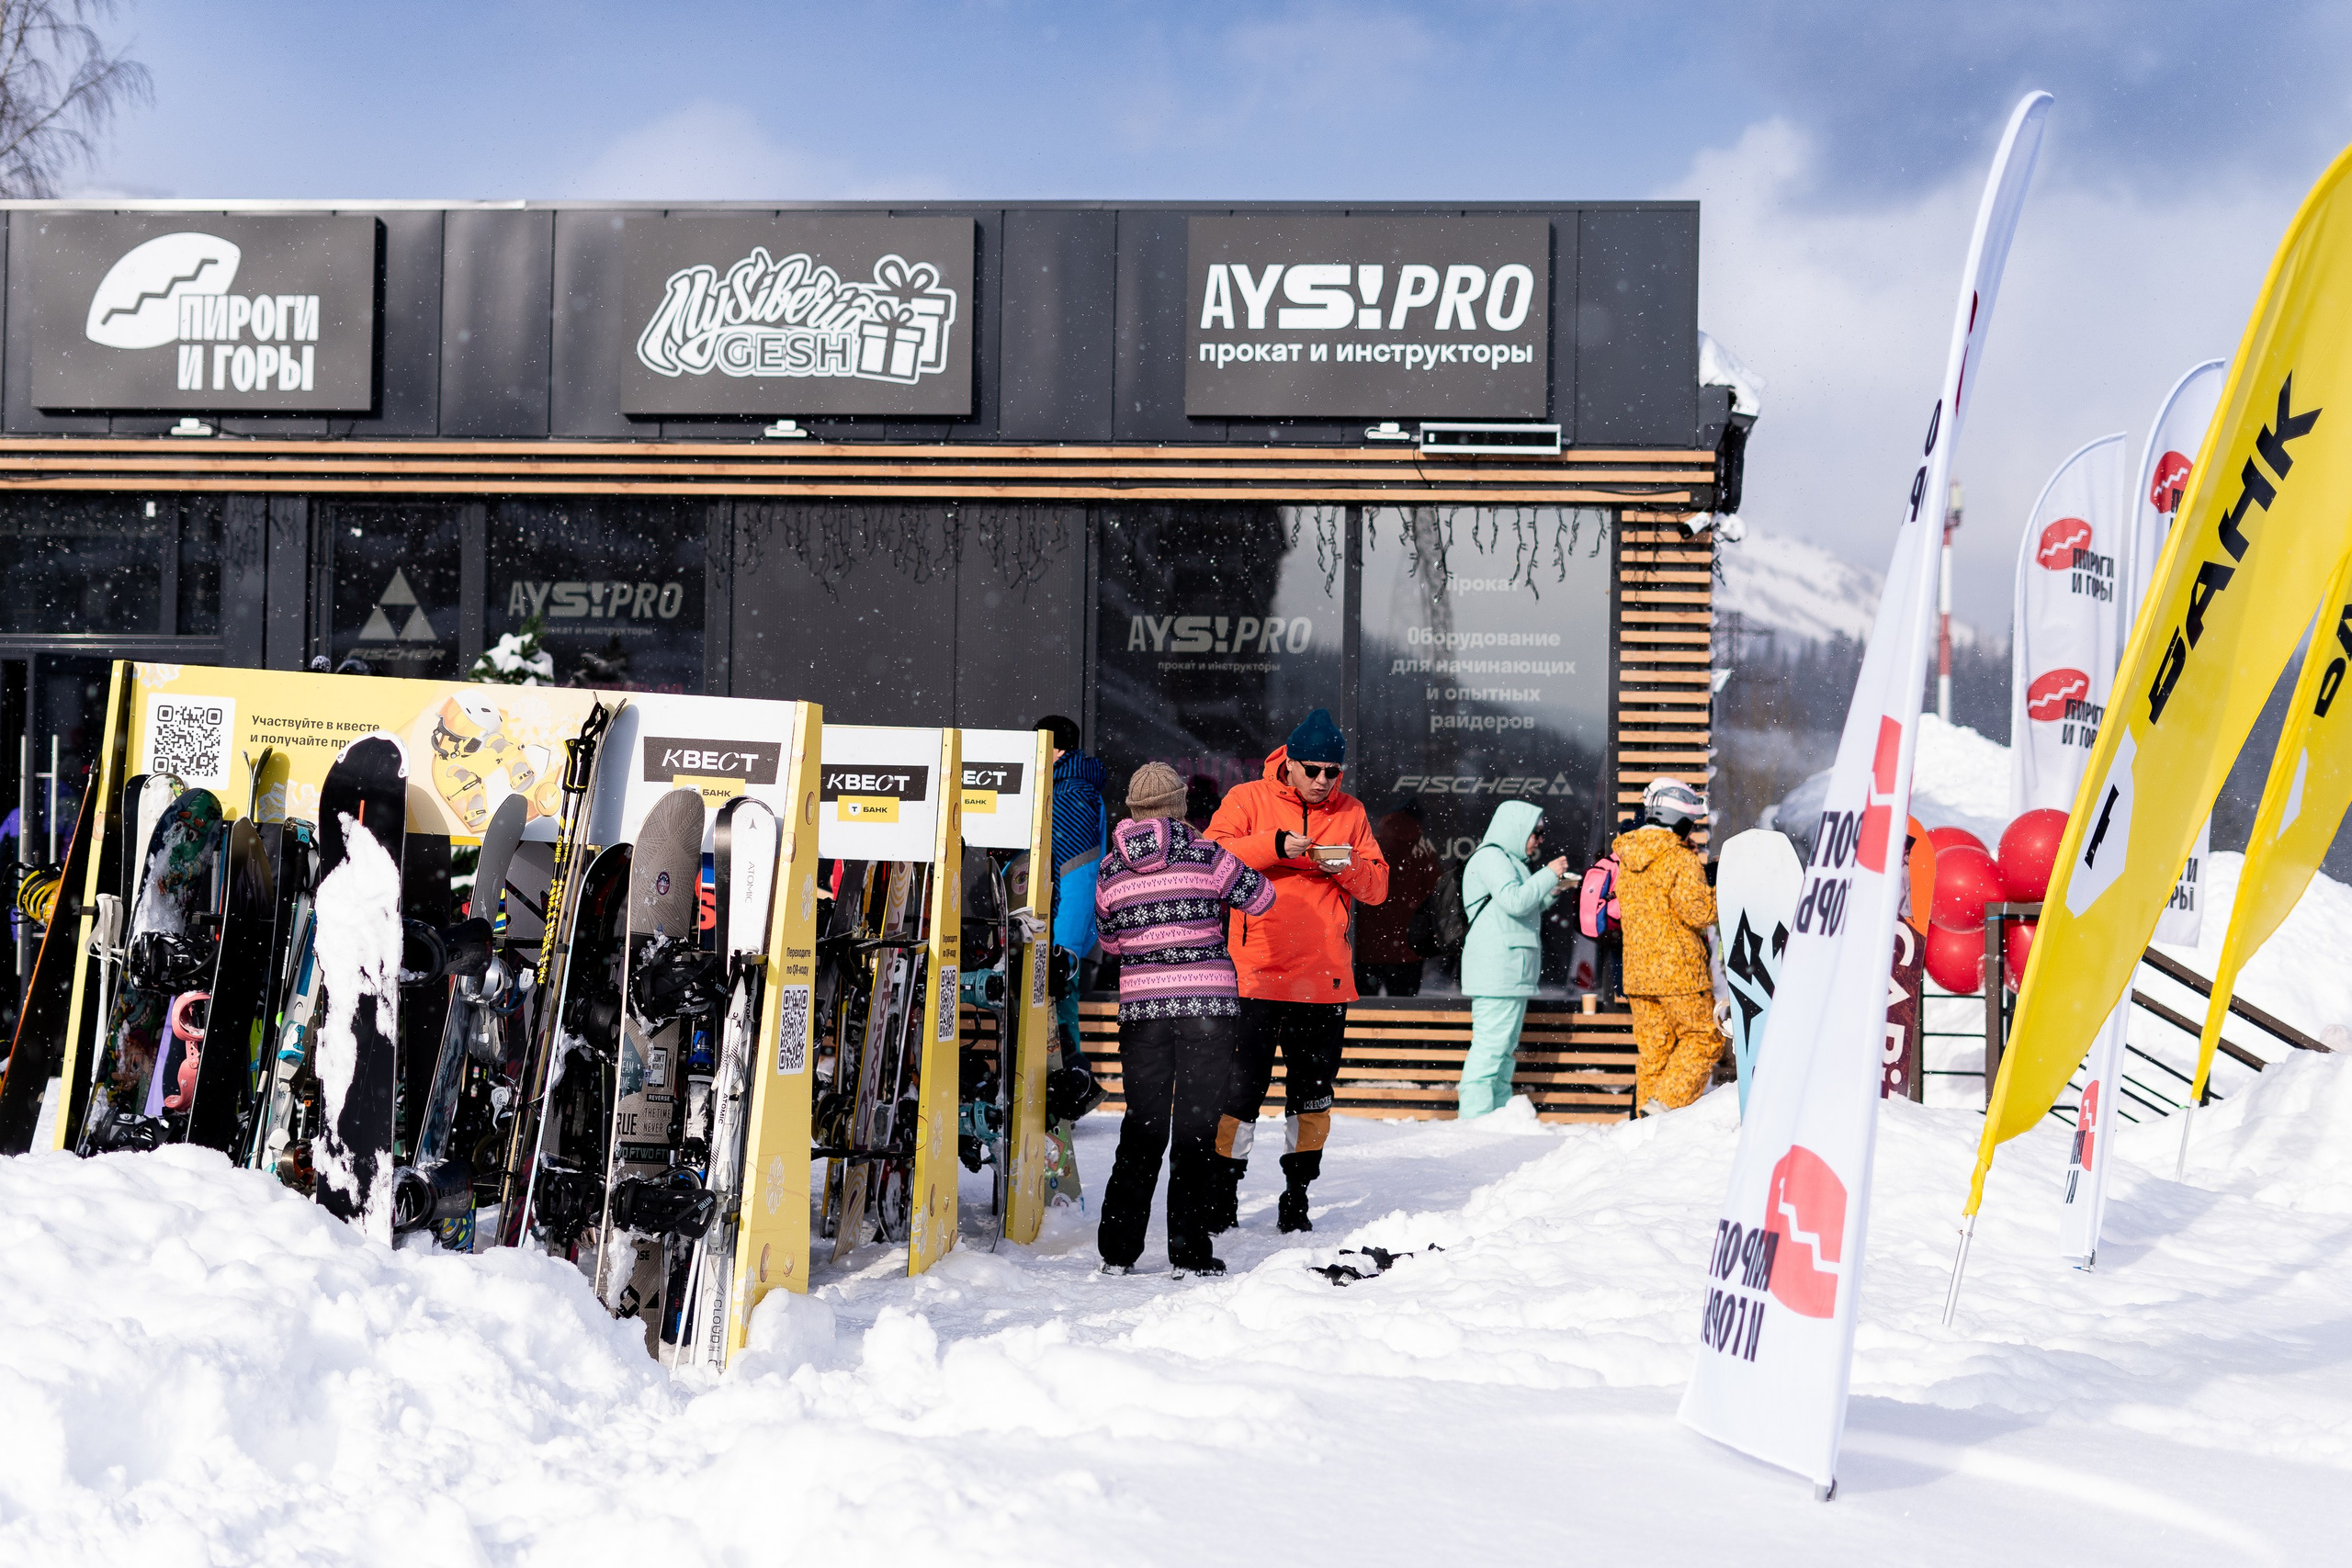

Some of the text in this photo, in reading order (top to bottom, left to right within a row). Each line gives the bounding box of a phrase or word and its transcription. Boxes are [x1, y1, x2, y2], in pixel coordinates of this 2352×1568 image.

[179, 294, 320, 343] ПИРОГИ
[722, 334, 852, 371] GESH
[1199, 343, 1533, 371] прокат и инструкторы
[177, 344, 315, 392] И ГОРЫ
[1446, 575, 1521, 596] Прокат
[2072, 572, 2113, 603] И ГОРЫ
[1407, 626, 1561, 651] Оборудование
[346, 647, 447, 661] FISCHER
[1158, 660, 1281, 673] прокат и инструкторы
[1391, 658, 1577, 677] для начинающих
[1426, 687, 1541, 702] и опытных
[252, 715, 379, 732] Участвуйте в квесте
[1430, 709, 1535, 734] райдеров
[250, 734, 258, 742] и
[261, 735, 328, 747] получайте
[2079, 726, 2098, 749] ГОР
[662, 749, 759, 773] КВЕСТ
[827, 773, 910, 792] КВЕСТ
[962, 770, 1007, 786] ЕСТ
[1391, 774, 1548, 795] FISCHER
[702, 788, 732, 797] БАНК
[554, 835, 563, 863] COBER
[744, 861, 755, 904] ATOMIC
[718, 1094, 729, 1125] ATOMIC
[643, 1122, 663, 1134] NEVER
[710, 1299, 722, 1344] CLOUD
